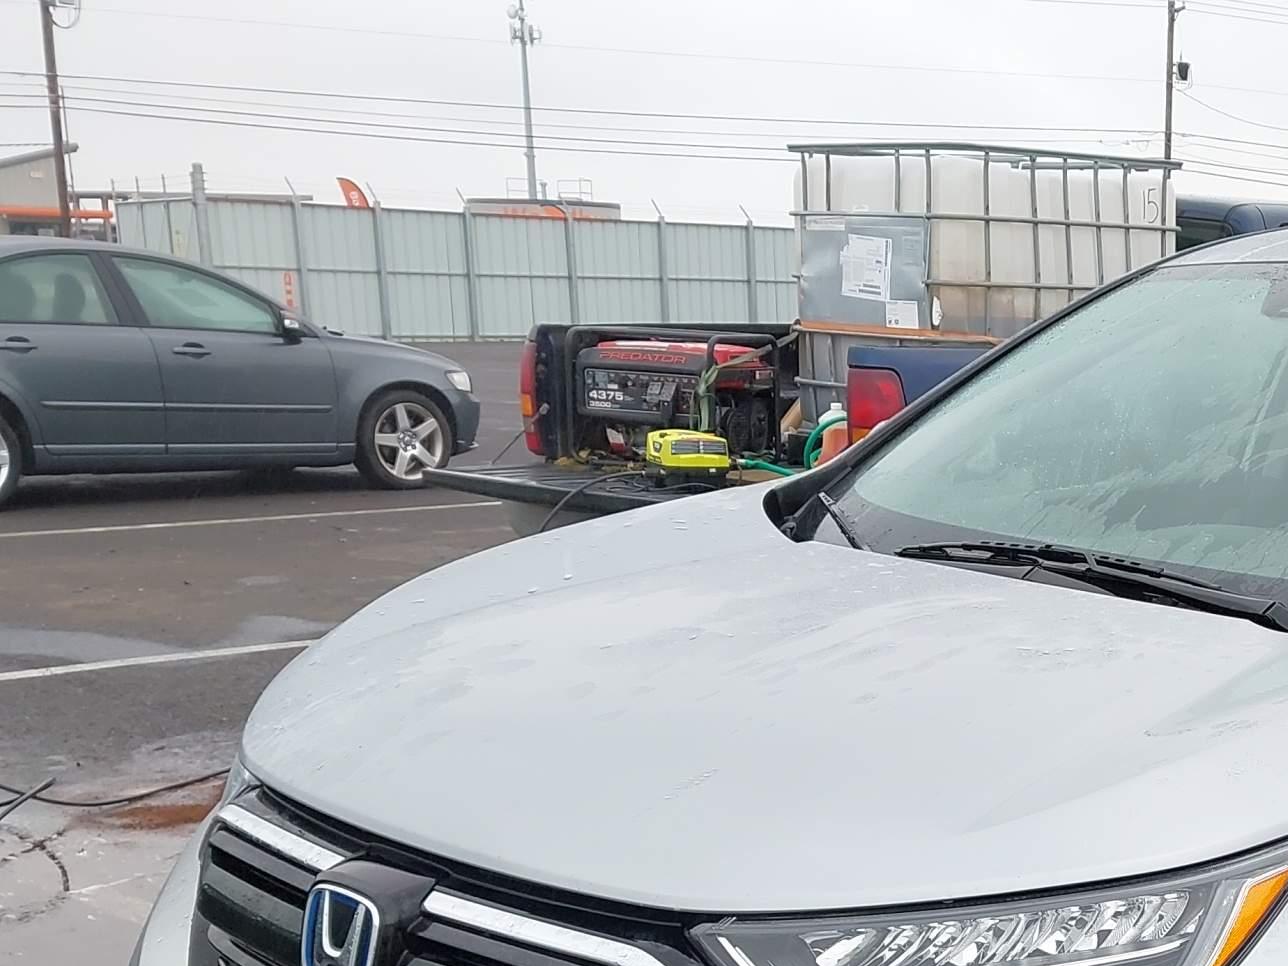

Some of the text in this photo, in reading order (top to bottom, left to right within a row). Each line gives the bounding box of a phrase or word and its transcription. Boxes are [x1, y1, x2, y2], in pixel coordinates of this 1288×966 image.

[1142, 187, 1159, 224] 15
[599, 351, 688, 364] PREDATOR
[588, 390, 624, 401] 4375
[588, 400, 612, 408] 3500
